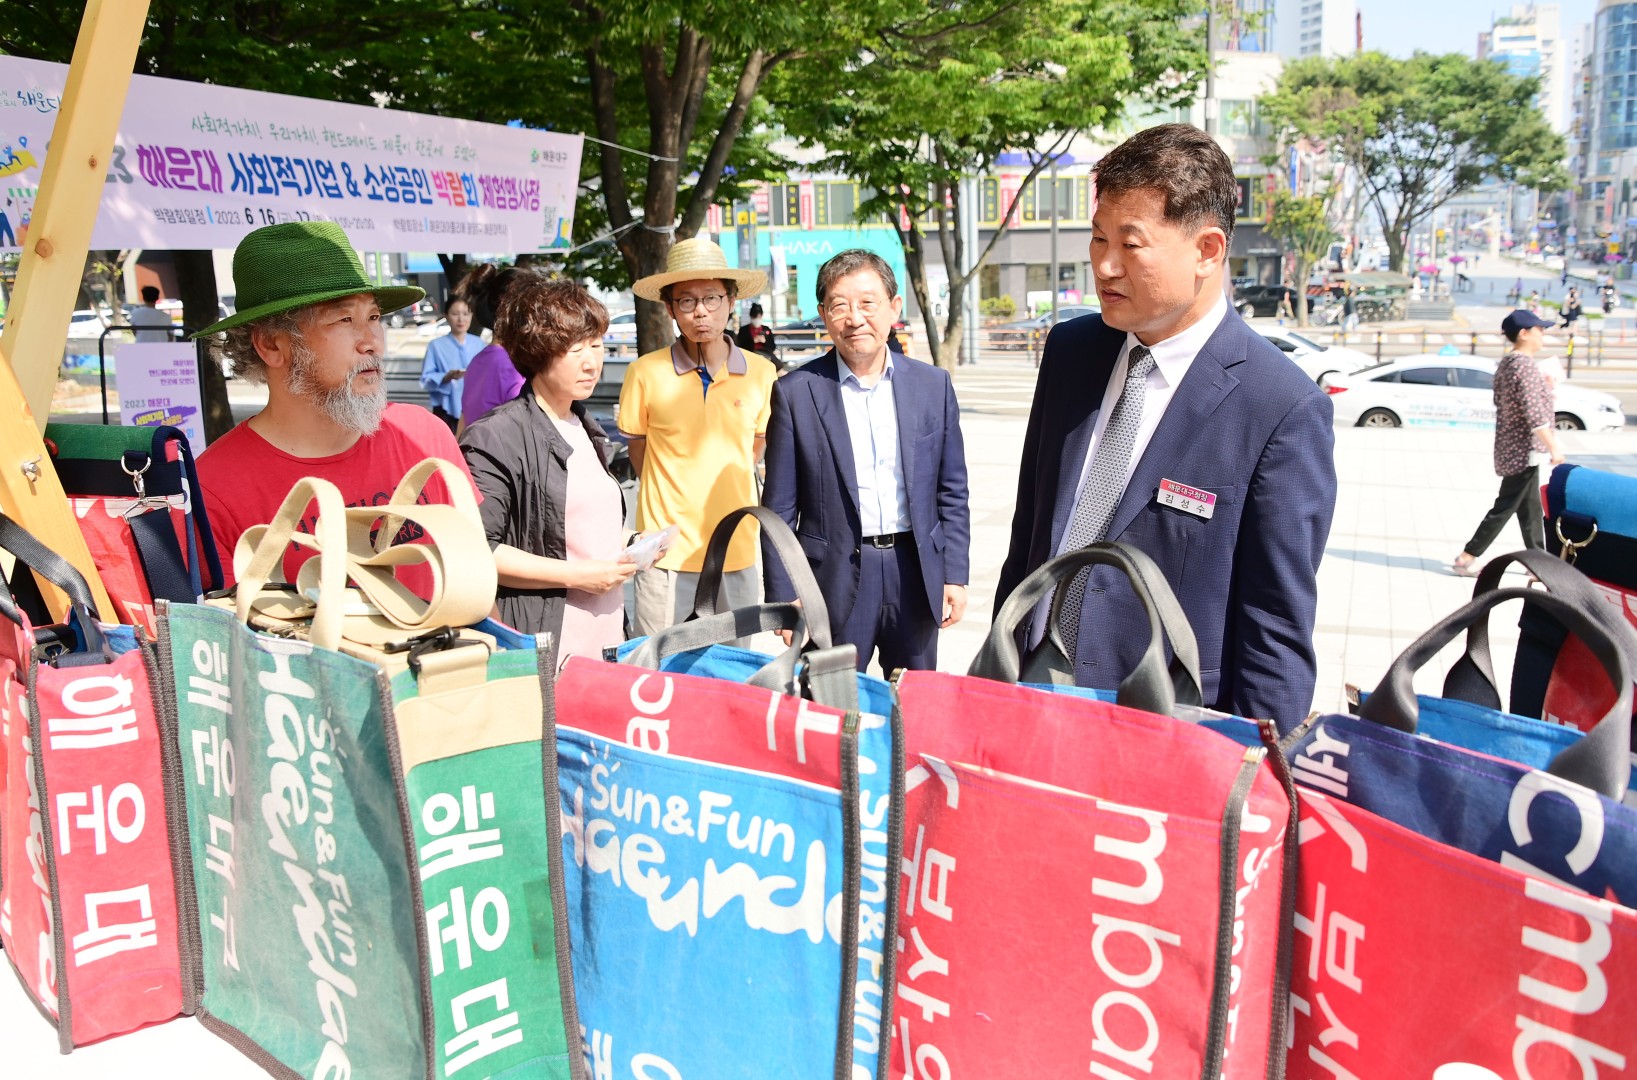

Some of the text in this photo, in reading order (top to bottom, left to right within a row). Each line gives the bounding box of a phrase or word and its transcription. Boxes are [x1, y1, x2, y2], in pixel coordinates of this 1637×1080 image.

[136, 144, 223, 193] 해운대
[227, 152, 343, 198] 사회적기업
[340, 161, 361, 197] &
[364, 163, 433, 204] 소상공인
[431, 170, 479, 207] 박람회
[478, 174, 540, 211] 체험행사장
[153, 207, 206, 225] 박람회일정
[125, 400, 146, 408] 2023
[1165, 493, 1206, 514] 김성수
[1168, 483, 1208, 502] 해운대구청장
[49, 673, 157, 967] 해운대
[187, 639, 240, 972] 해운대구
[307, 718, 358, 968] Sun&Fun
[589, 763, 795, 863] Sun&Fun
[256, 640, 357, 1080] Haeundae
[419, 784, 523, 1077] 해운대
